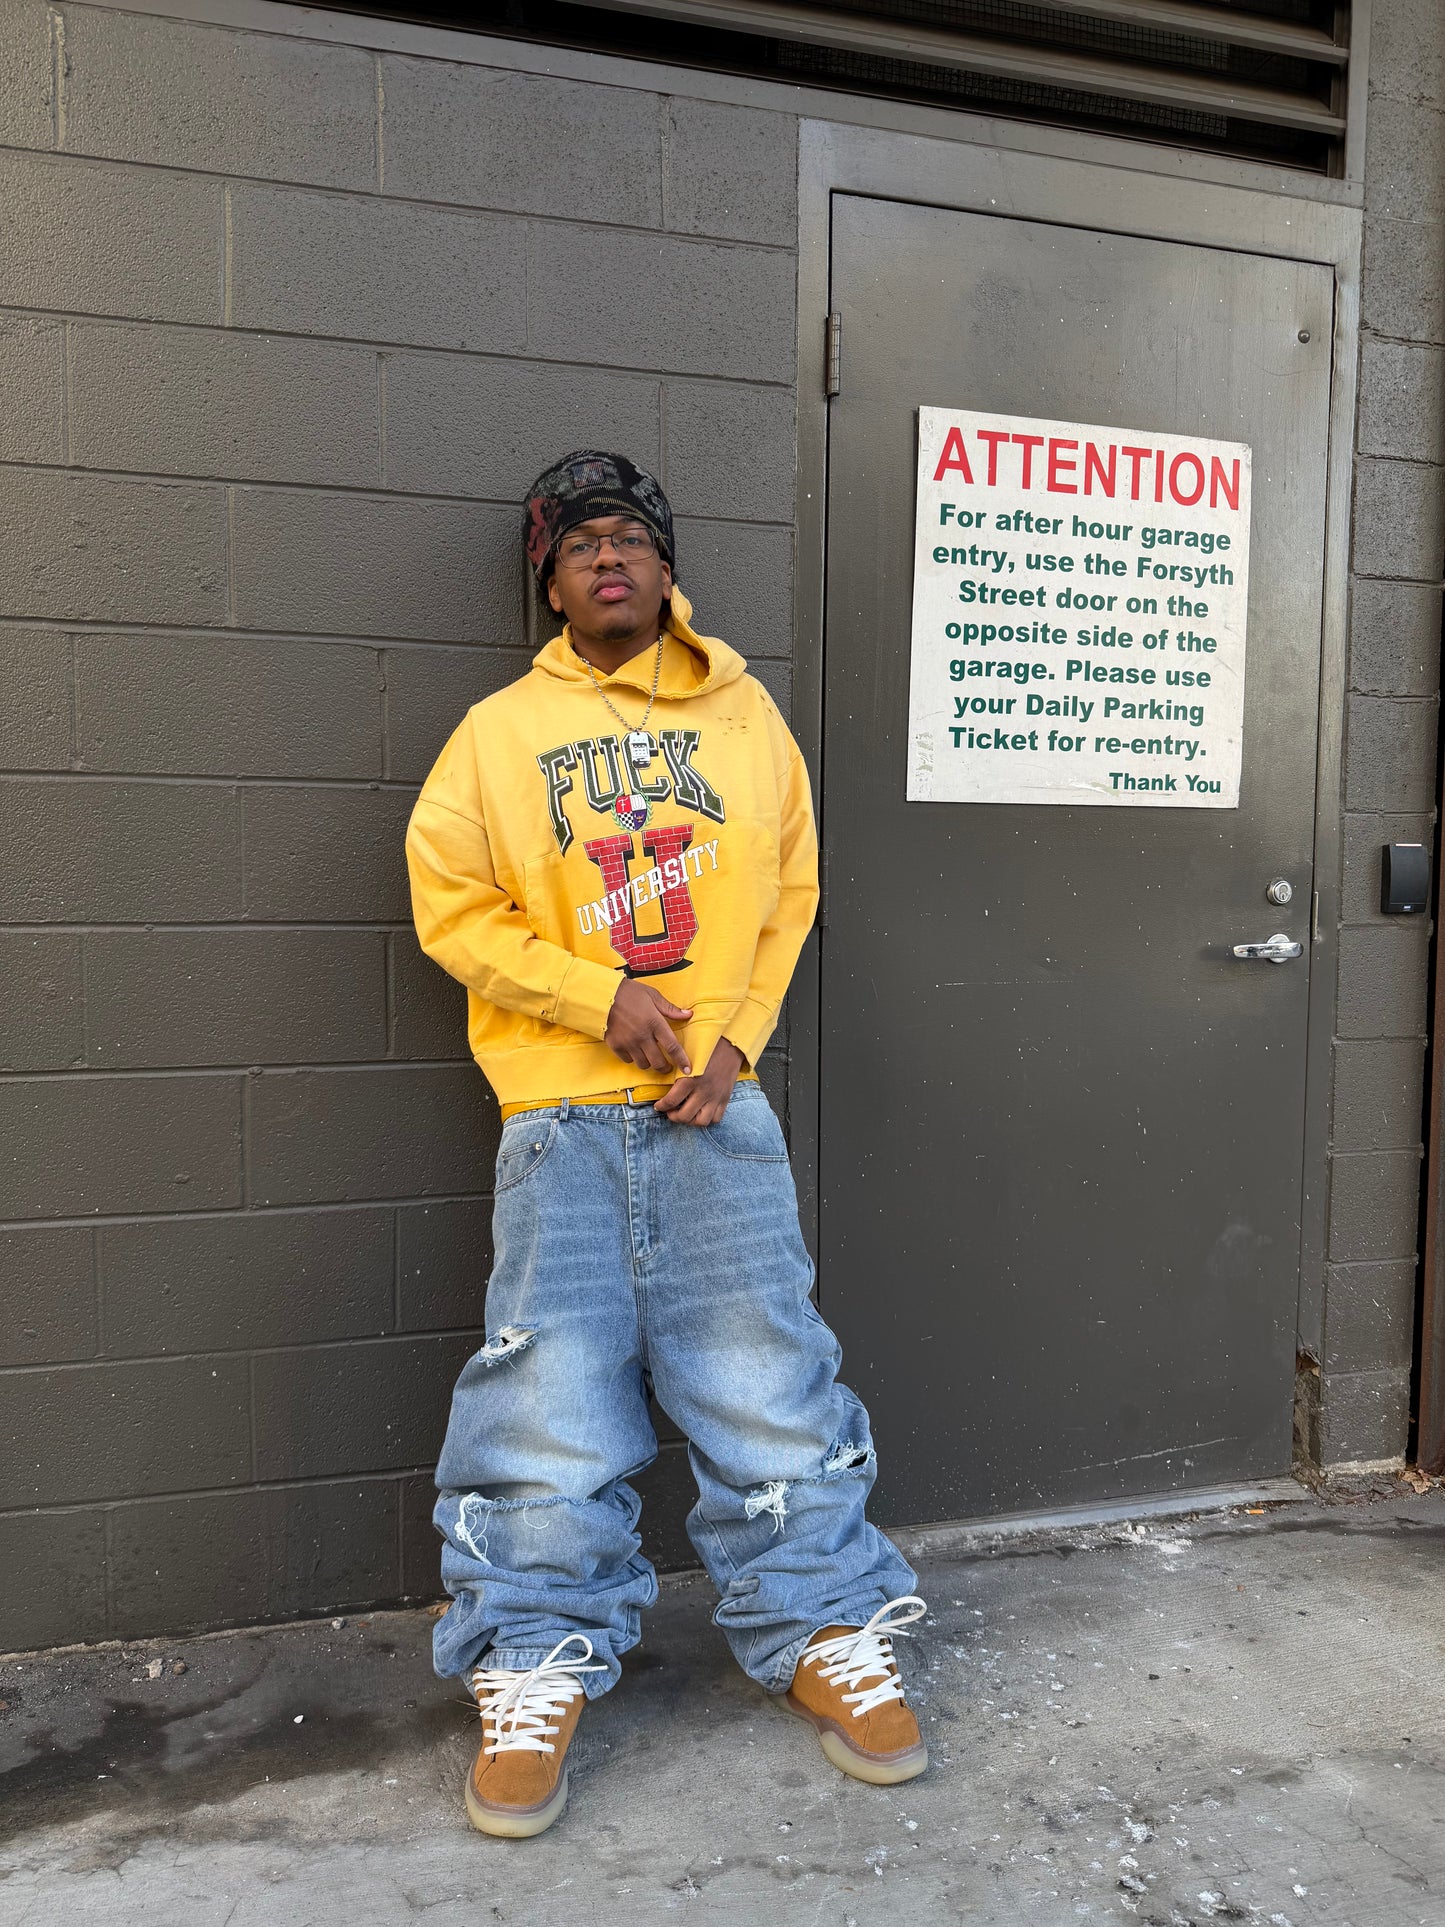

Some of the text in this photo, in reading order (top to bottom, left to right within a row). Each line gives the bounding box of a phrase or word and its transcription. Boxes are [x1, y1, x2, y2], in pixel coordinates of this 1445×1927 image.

[932, 426, 1241, 511] ATTENTION
[939, 503, 1231, 555] For after hour garage
[932, 544, 1234, 589] entry, use the Forsyth
[958, 579, 1209, 618] Street door on the
[944, 621, 1217, 653] opposite side of the
[949, 659, 1211, 688] garage. Please use
[953, 693, 1204, 727] your Daily Parking
[948, 726, 1206, 761] Ticket for re-entry.
[536, 730, 726, 857] FUCK
[1108, 772, 1221, 794] Thank You
[576, 839, 719, 936] UNIVERSITY
[583, 823, 699, 976] U
